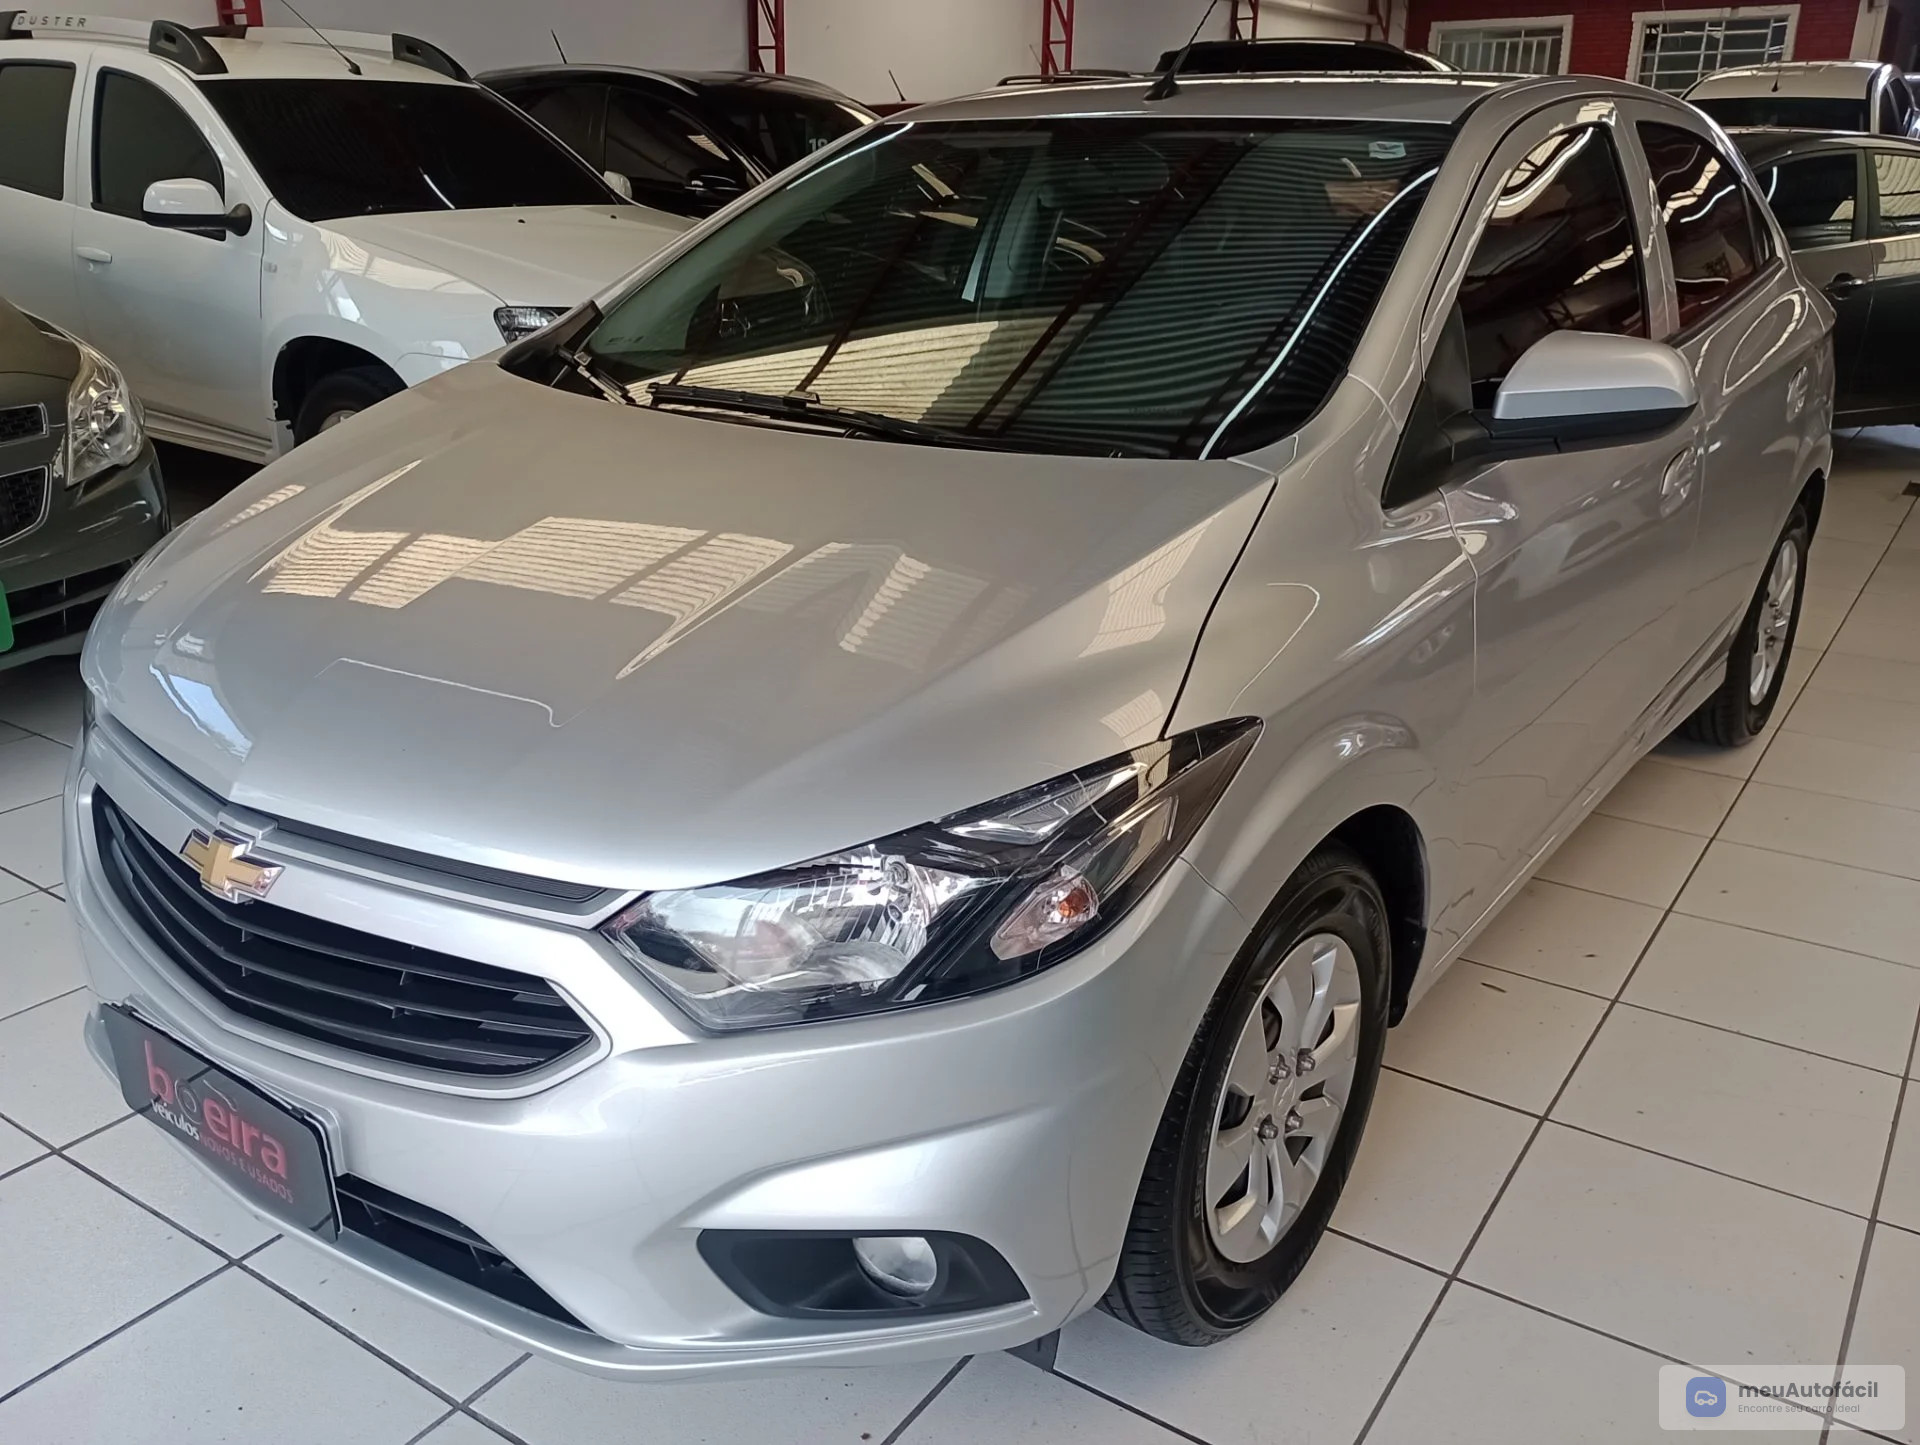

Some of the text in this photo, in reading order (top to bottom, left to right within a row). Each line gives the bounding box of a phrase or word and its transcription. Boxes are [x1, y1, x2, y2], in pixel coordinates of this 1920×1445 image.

[17, 16, 87, 27] DUSTER
[200, 1132, 237, 1166] NOVOS
[247, 1163, 293, 1204] USADOS
